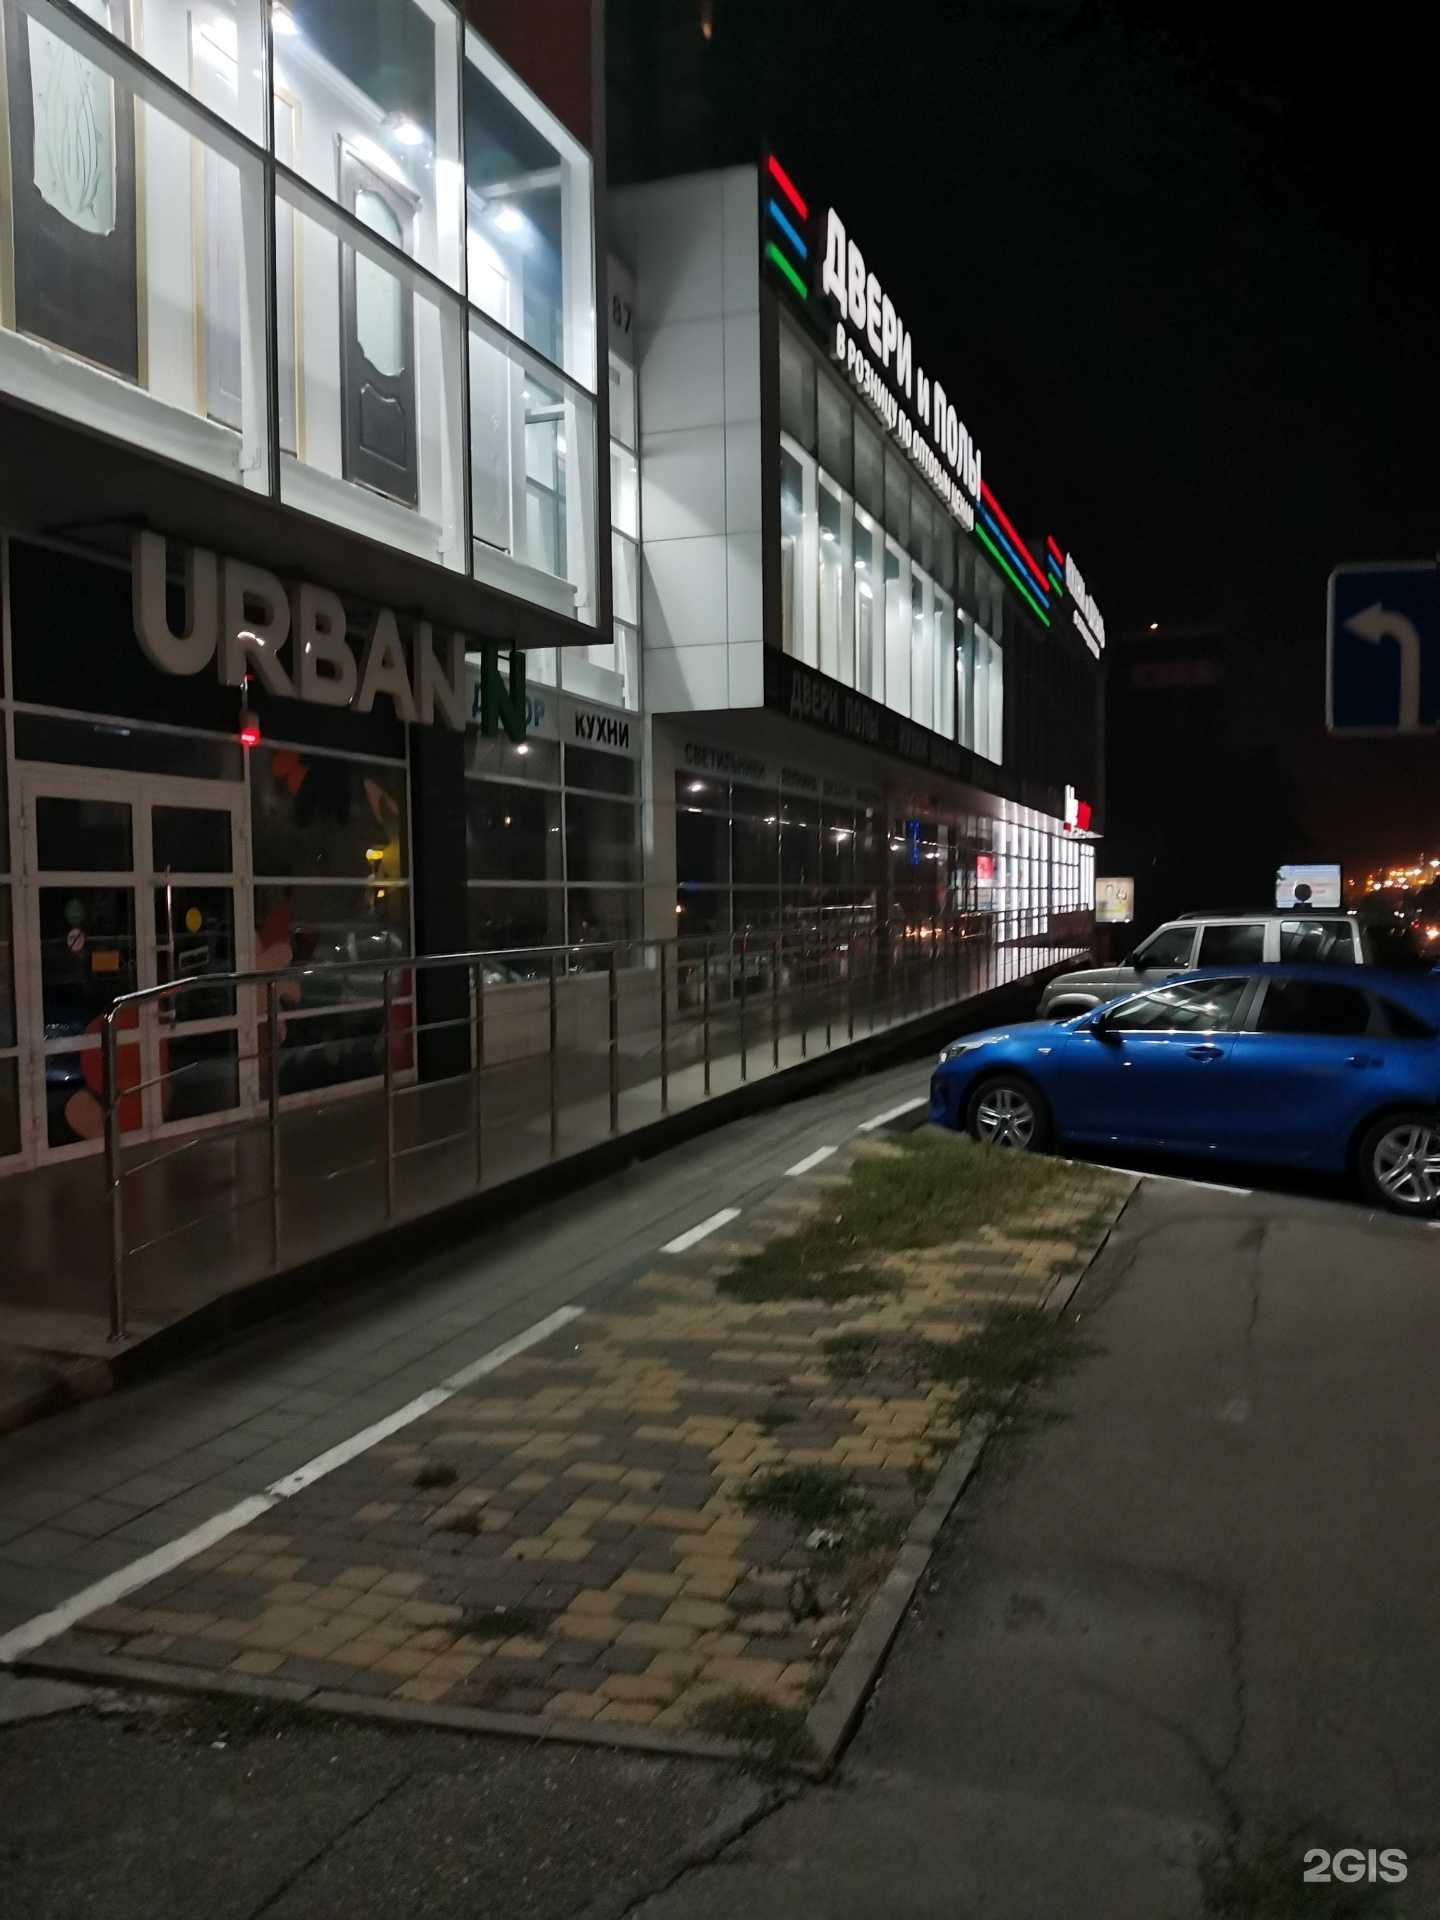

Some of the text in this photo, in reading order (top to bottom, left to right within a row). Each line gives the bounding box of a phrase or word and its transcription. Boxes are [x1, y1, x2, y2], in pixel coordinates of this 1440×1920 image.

[612, 295, 632, 334] 87
[823, 207, 912, 398] ДВЕРИ
[934, 380, 982, 501] ПОЛЫ
[836, 322, 846, 360] В
[847, 338, 898, 430] РОЗНИЦУ
[898, 409, 912, 449] ПО
[130, 529, 467, 733] URBAN
[575, 711, 629, 748] КУХНИ
